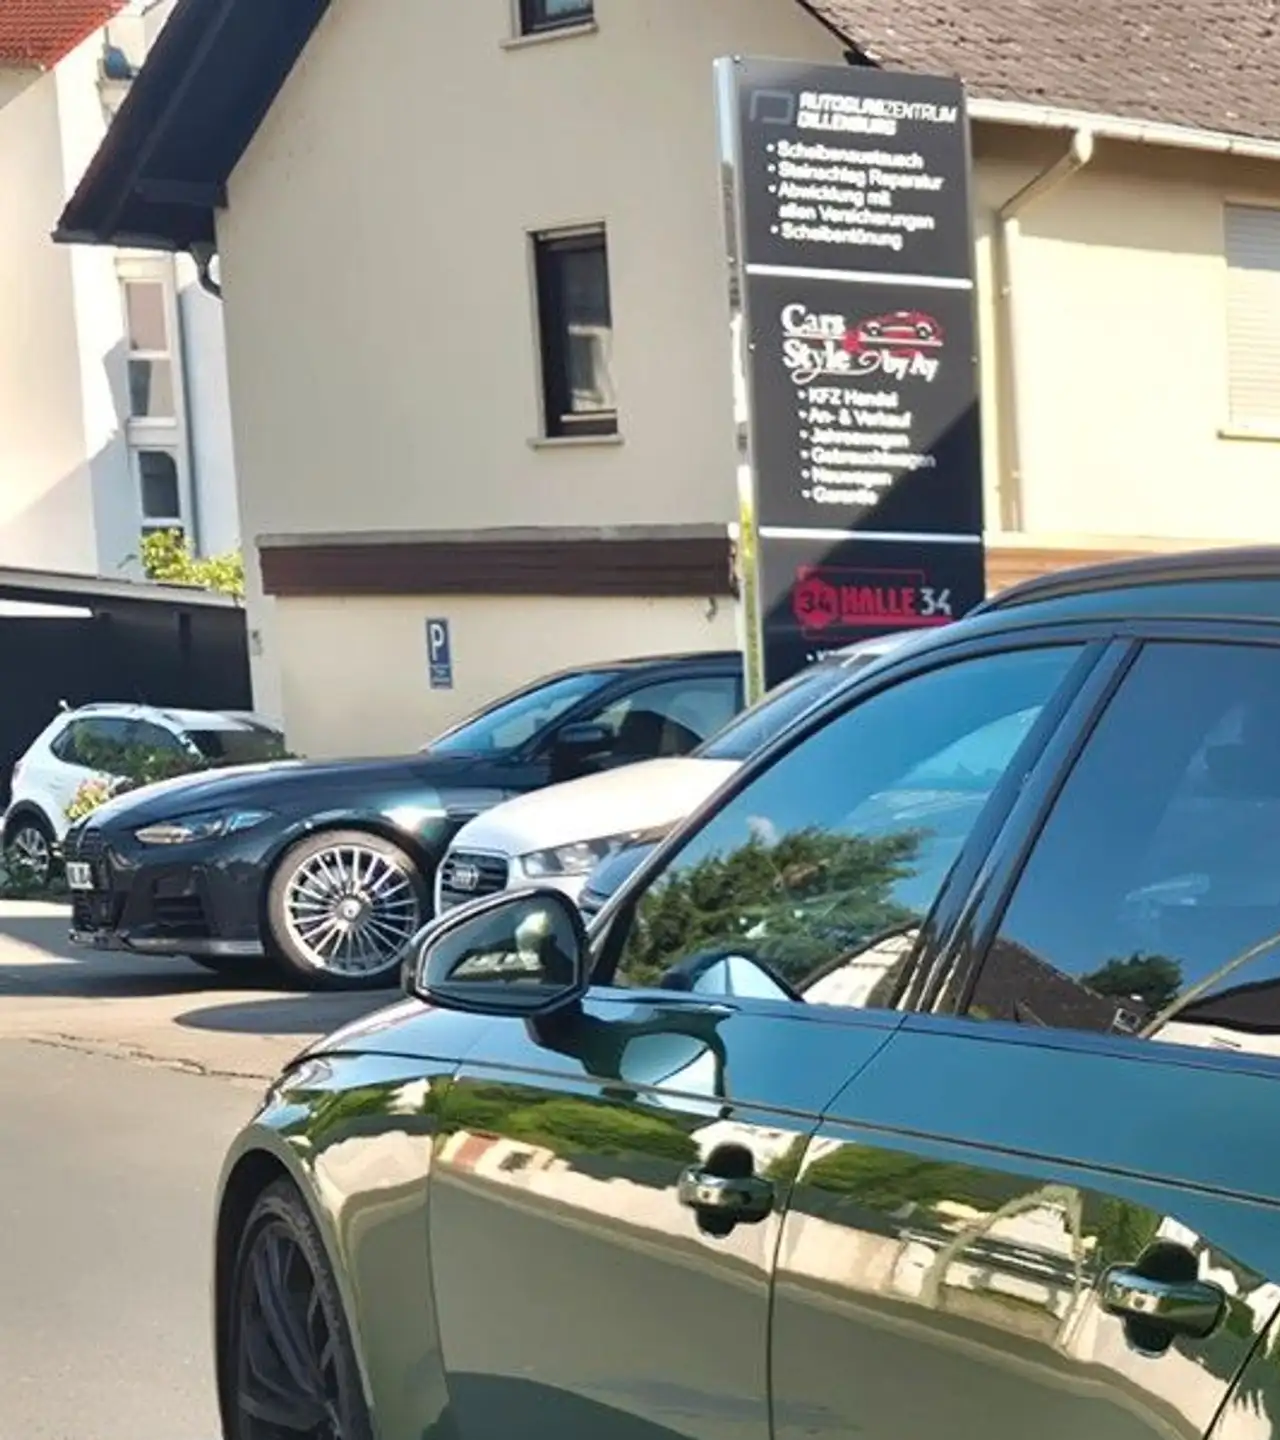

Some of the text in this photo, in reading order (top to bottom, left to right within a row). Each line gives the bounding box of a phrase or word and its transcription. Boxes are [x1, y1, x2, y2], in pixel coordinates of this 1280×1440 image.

[781, 303, 846, 337] Cars
[782, 338, 855, 384] Style
[880, 349, 909, 380] by
[842, 585, 952, 616] HALLE 34
[430, 623, 445, 662] P
